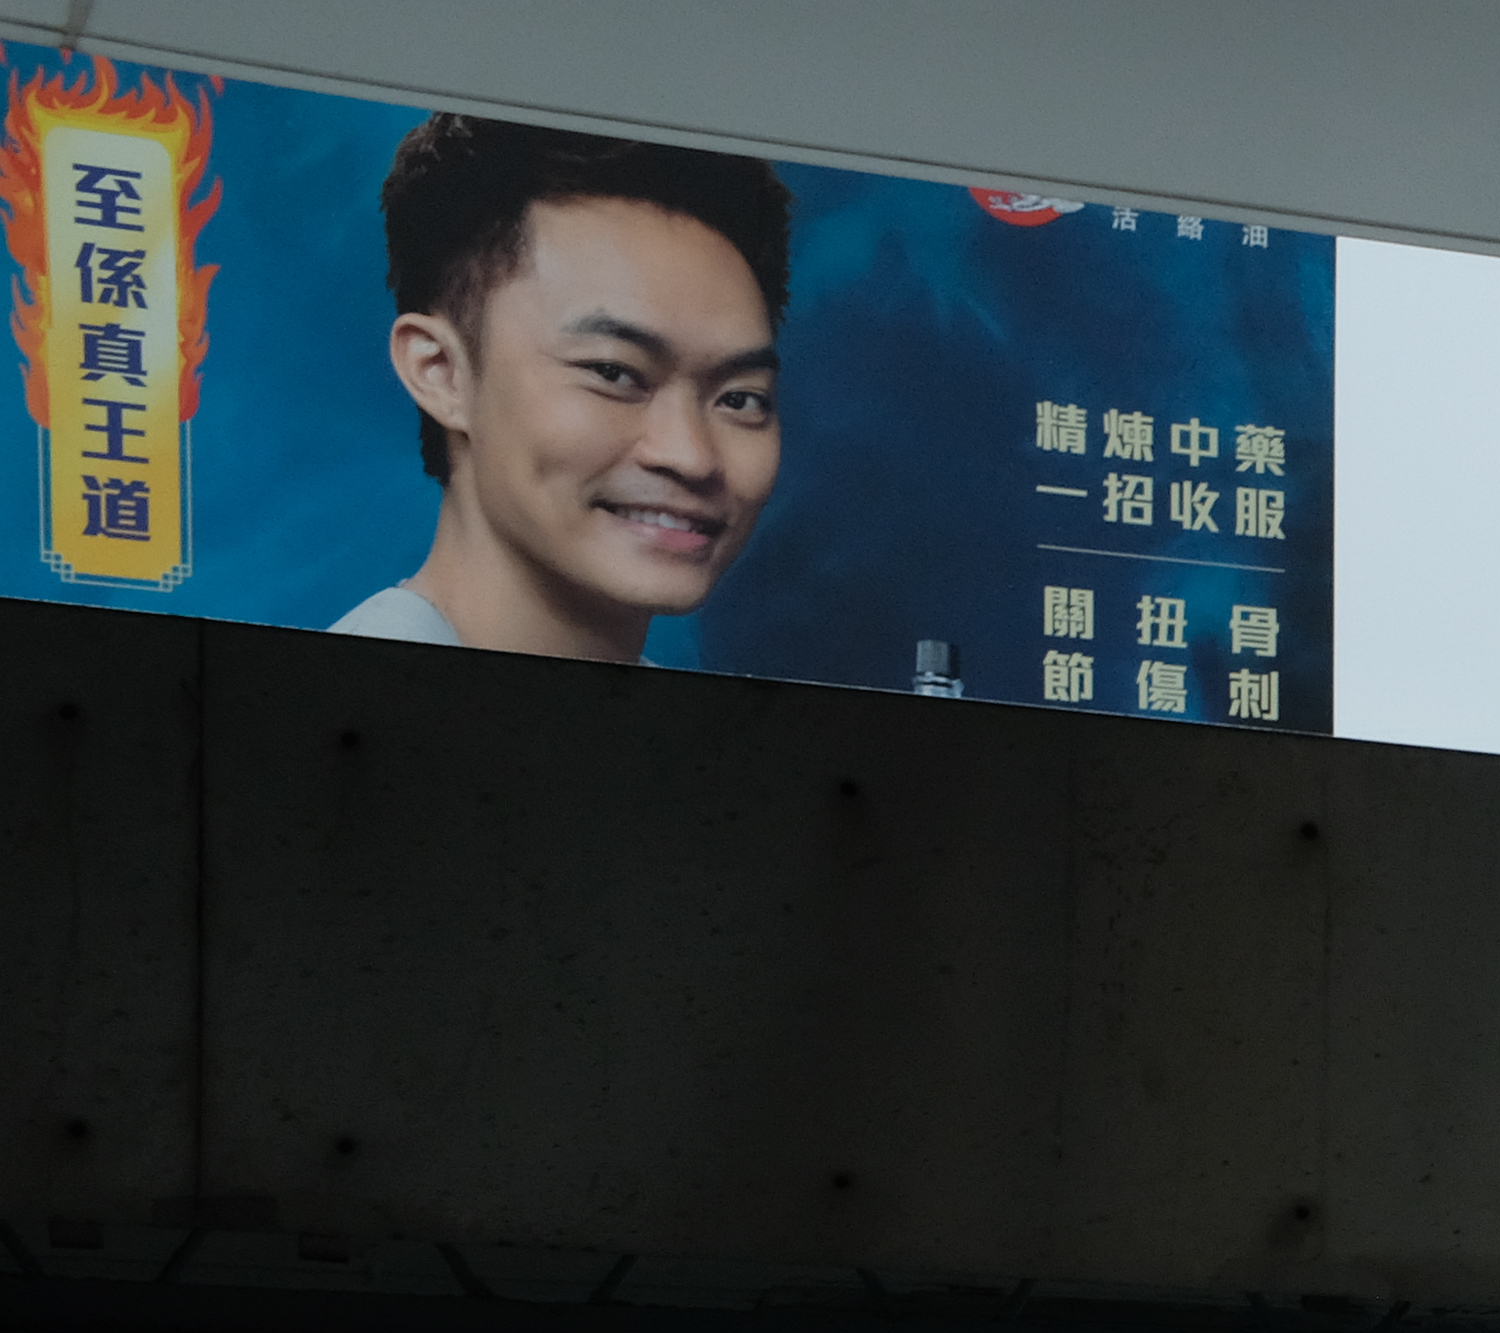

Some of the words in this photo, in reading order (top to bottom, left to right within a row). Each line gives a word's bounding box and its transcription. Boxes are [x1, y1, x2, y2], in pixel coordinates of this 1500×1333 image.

[72, 162, 152, 542] 至係真王道
[1035, 400, 1287, 476] 精煉中藥
[1035, 472, 1287, 540] 一招收服
